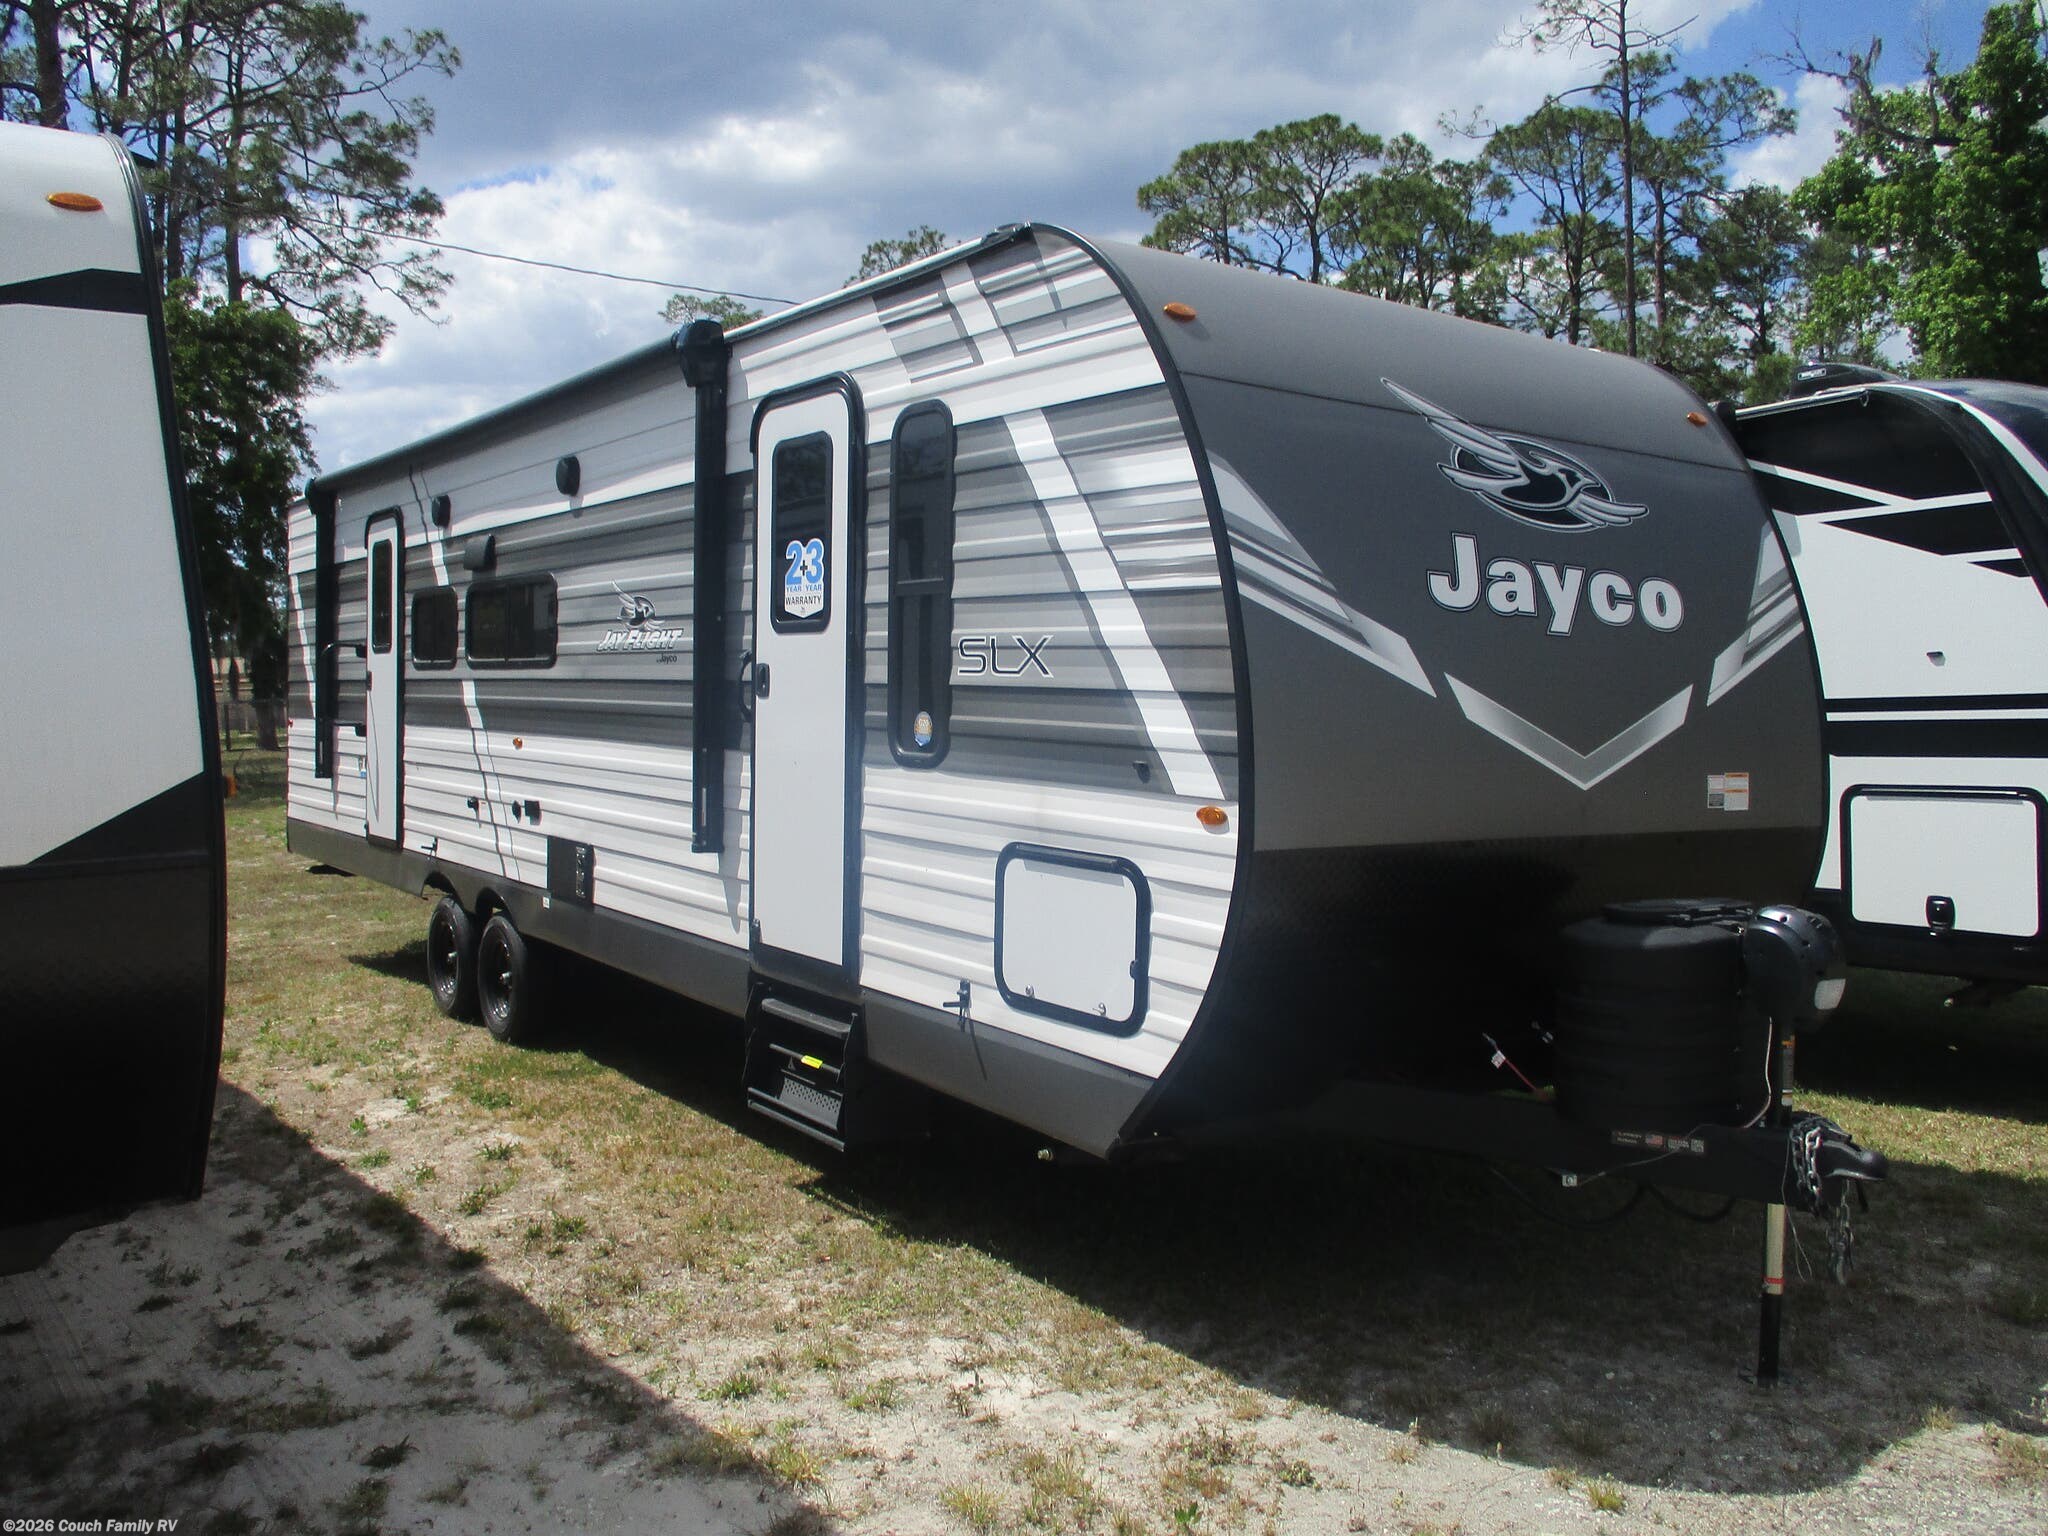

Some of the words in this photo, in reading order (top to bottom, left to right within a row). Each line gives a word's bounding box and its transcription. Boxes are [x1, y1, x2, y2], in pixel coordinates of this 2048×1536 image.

[786, 585, 802, 593] YEAR
[806, 584, 822, 592] YEAR
[1427, 532, 1685, 637] Jayco
[785, 595, 822, 605] WARRANTY
[596, 629, 628, 652] JAY
[622, 628, 684, 650] FLIGHT
[958, 635, 1054, 678] SLX
